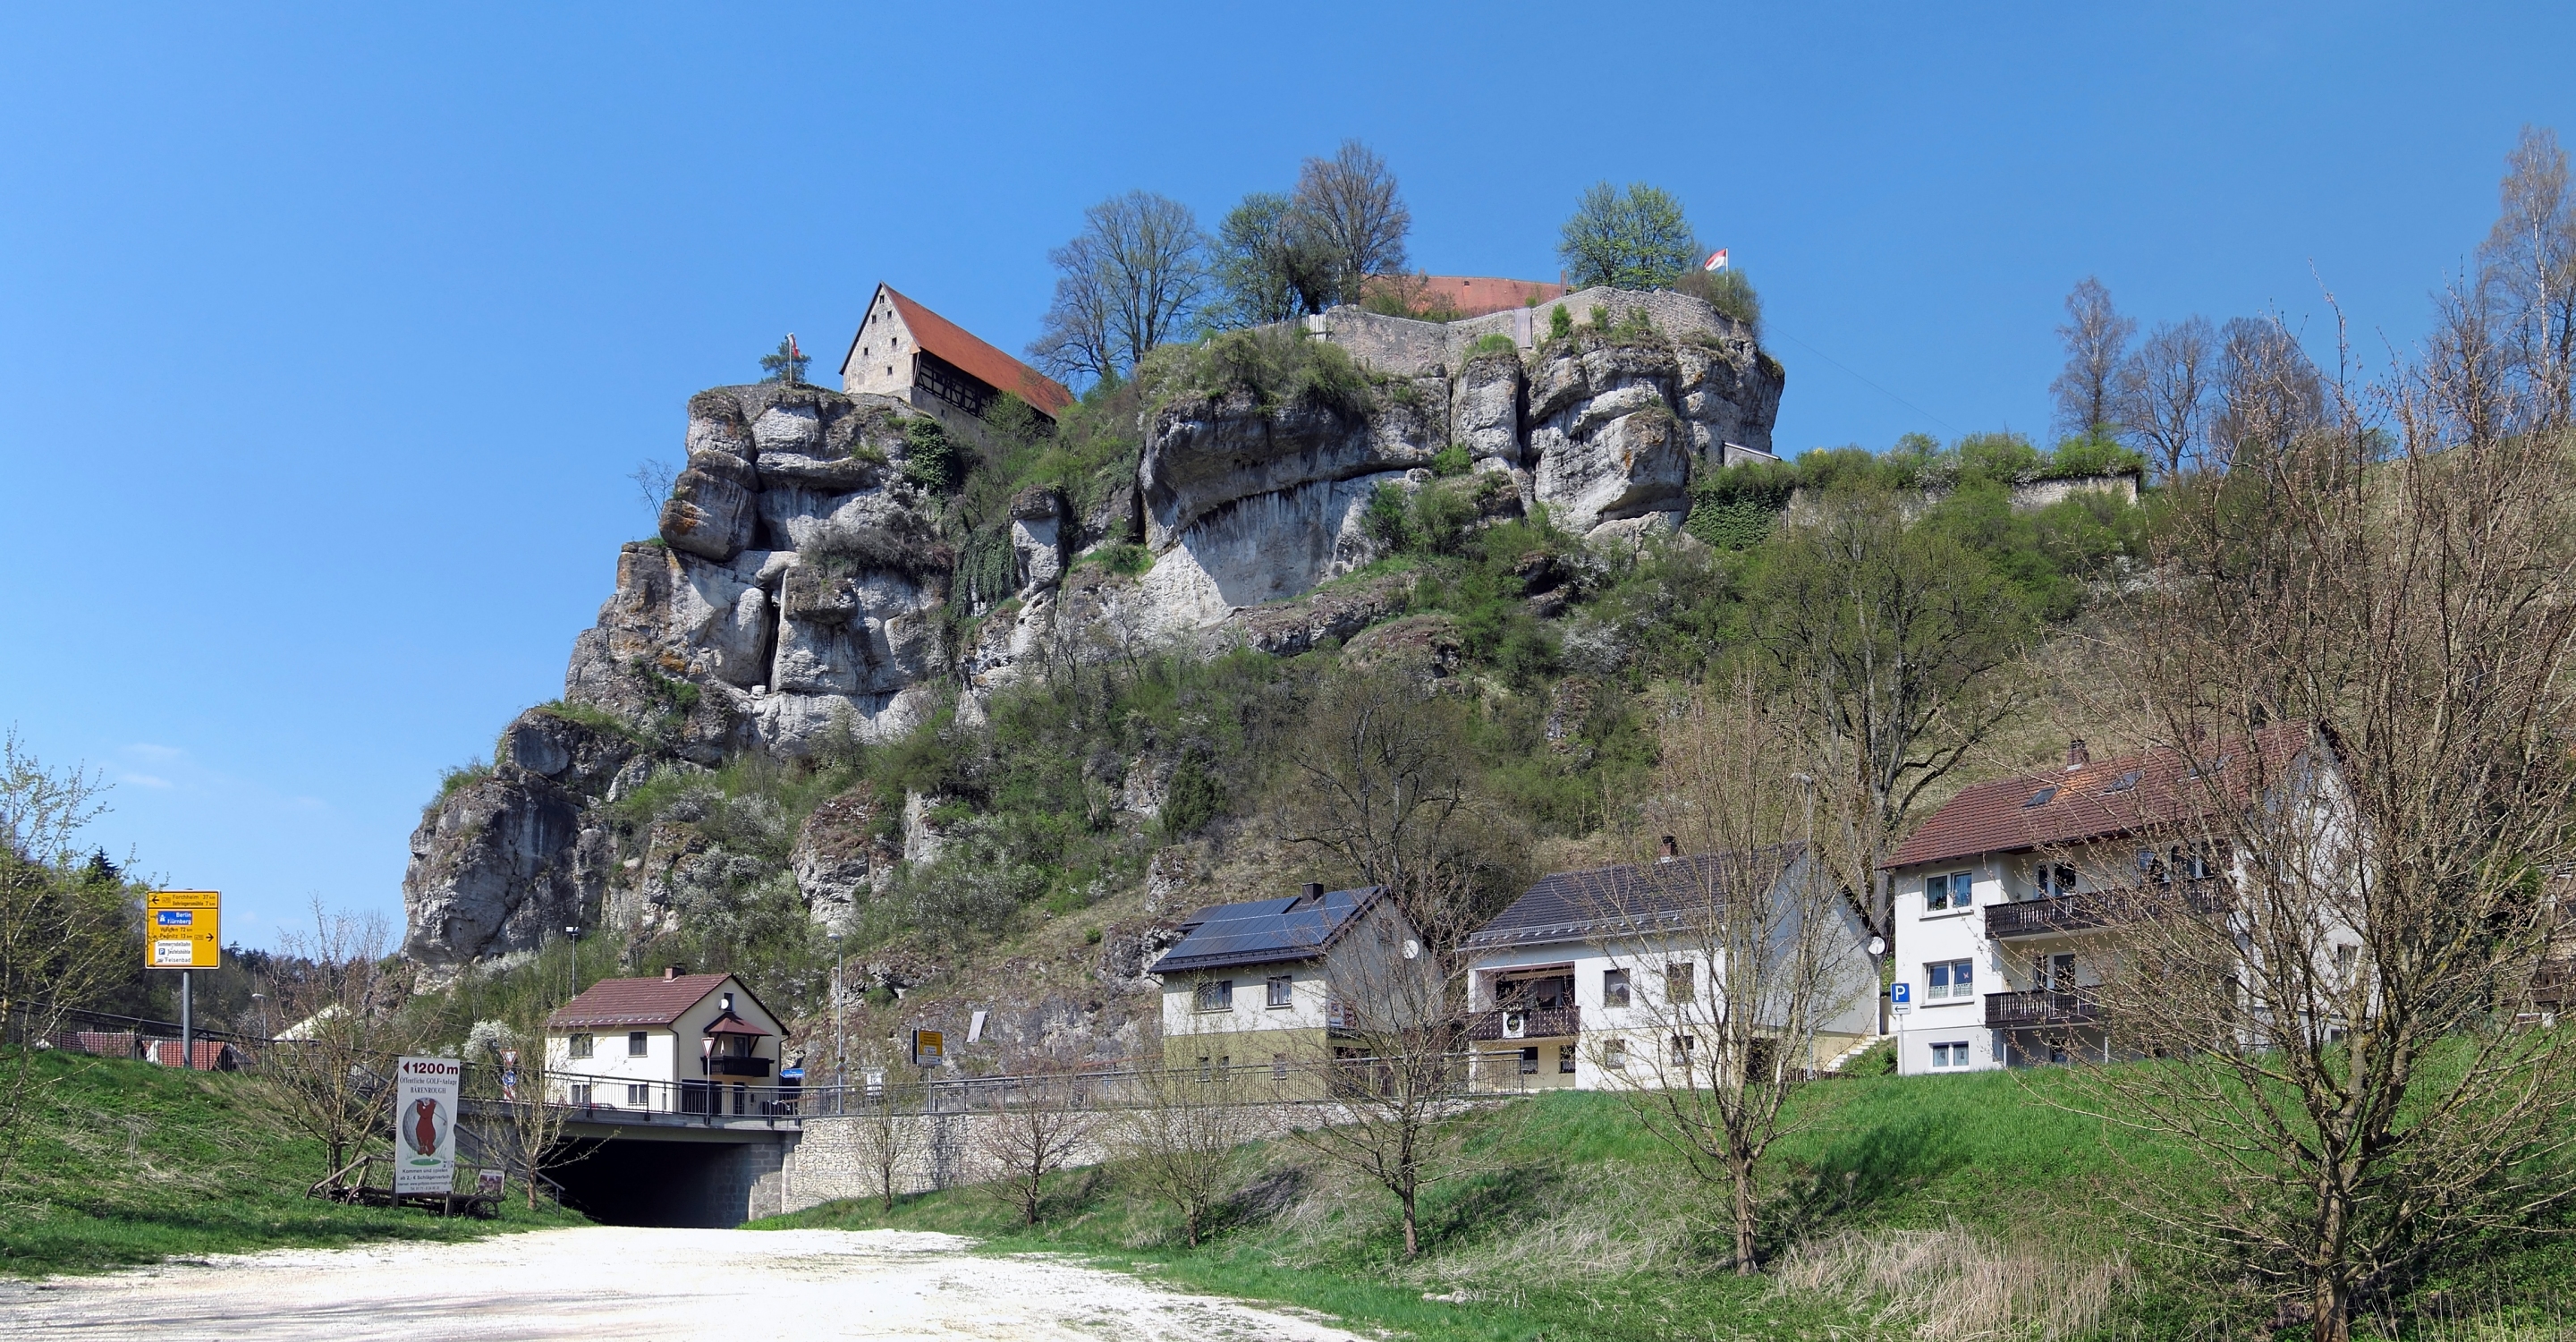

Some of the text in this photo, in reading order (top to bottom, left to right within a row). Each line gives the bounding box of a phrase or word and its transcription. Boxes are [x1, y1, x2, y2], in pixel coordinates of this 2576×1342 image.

[1895, 985, 1905, 1000] P
[412, 1062, 458, 1074] 1200 m
[427, 1077, 457, 1085] GOLF-Anlage
[411, 1085, 445, 1093] BÄRENROUGH
